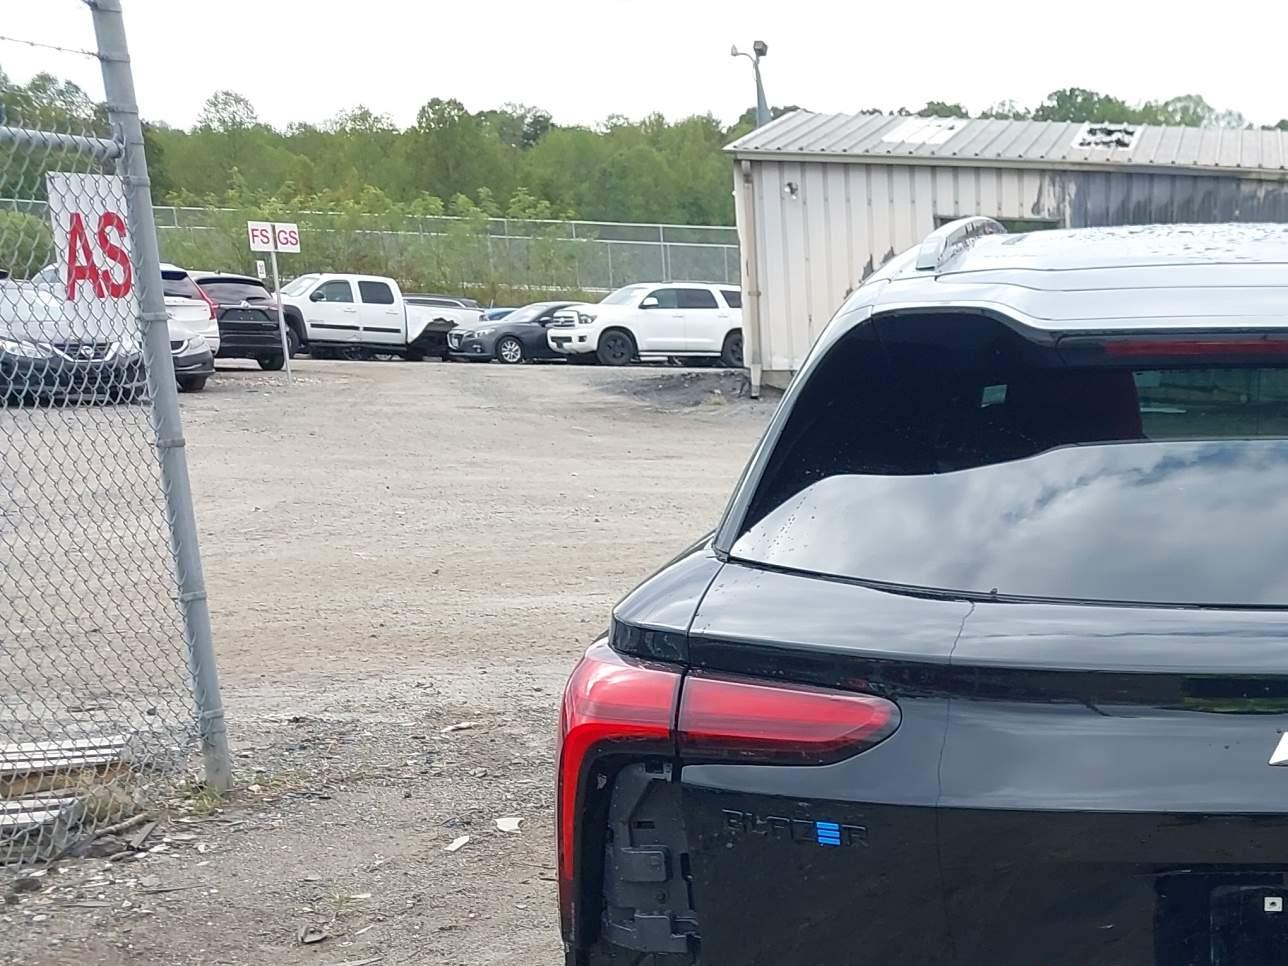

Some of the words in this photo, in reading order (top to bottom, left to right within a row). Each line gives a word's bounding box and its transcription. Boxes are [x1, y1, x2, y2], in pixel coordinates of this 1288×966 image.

[250, 228, 271, 245] FS
[277, 229, 299, 247] GS
[67, 212, 132, 301] AS
